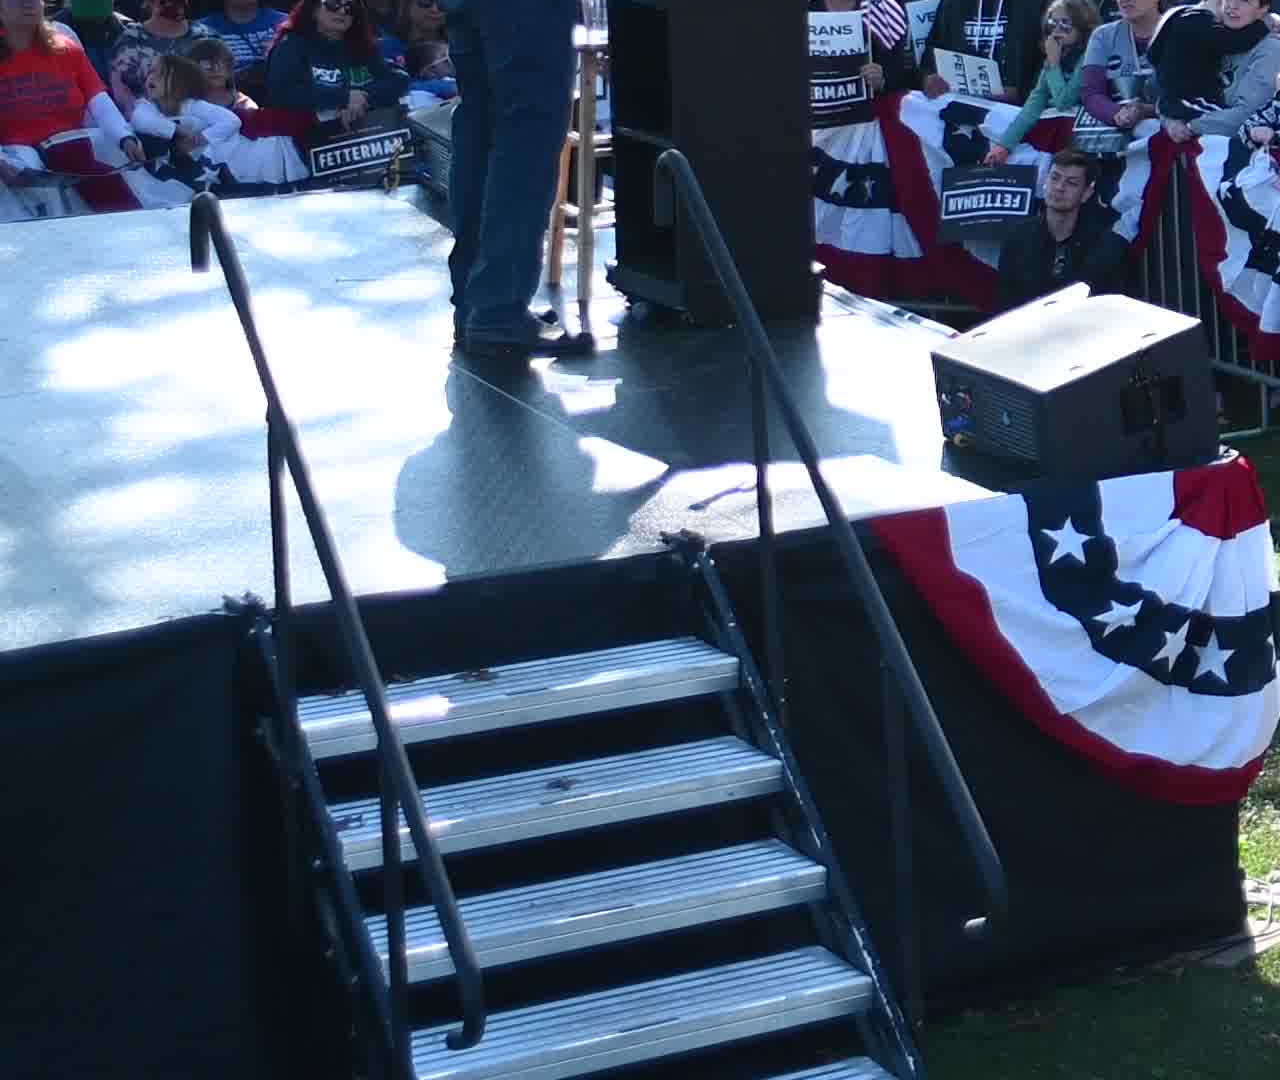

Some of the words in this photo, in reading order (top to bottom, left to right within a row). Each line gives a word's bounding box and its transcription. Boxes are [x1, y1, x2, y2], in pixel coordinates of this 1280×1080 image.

[812, 82, 857, 102] RMAN
[319, 137, 405, 169] FETTERMAN
[948, 192, 1022, 211] FETTERMAN
